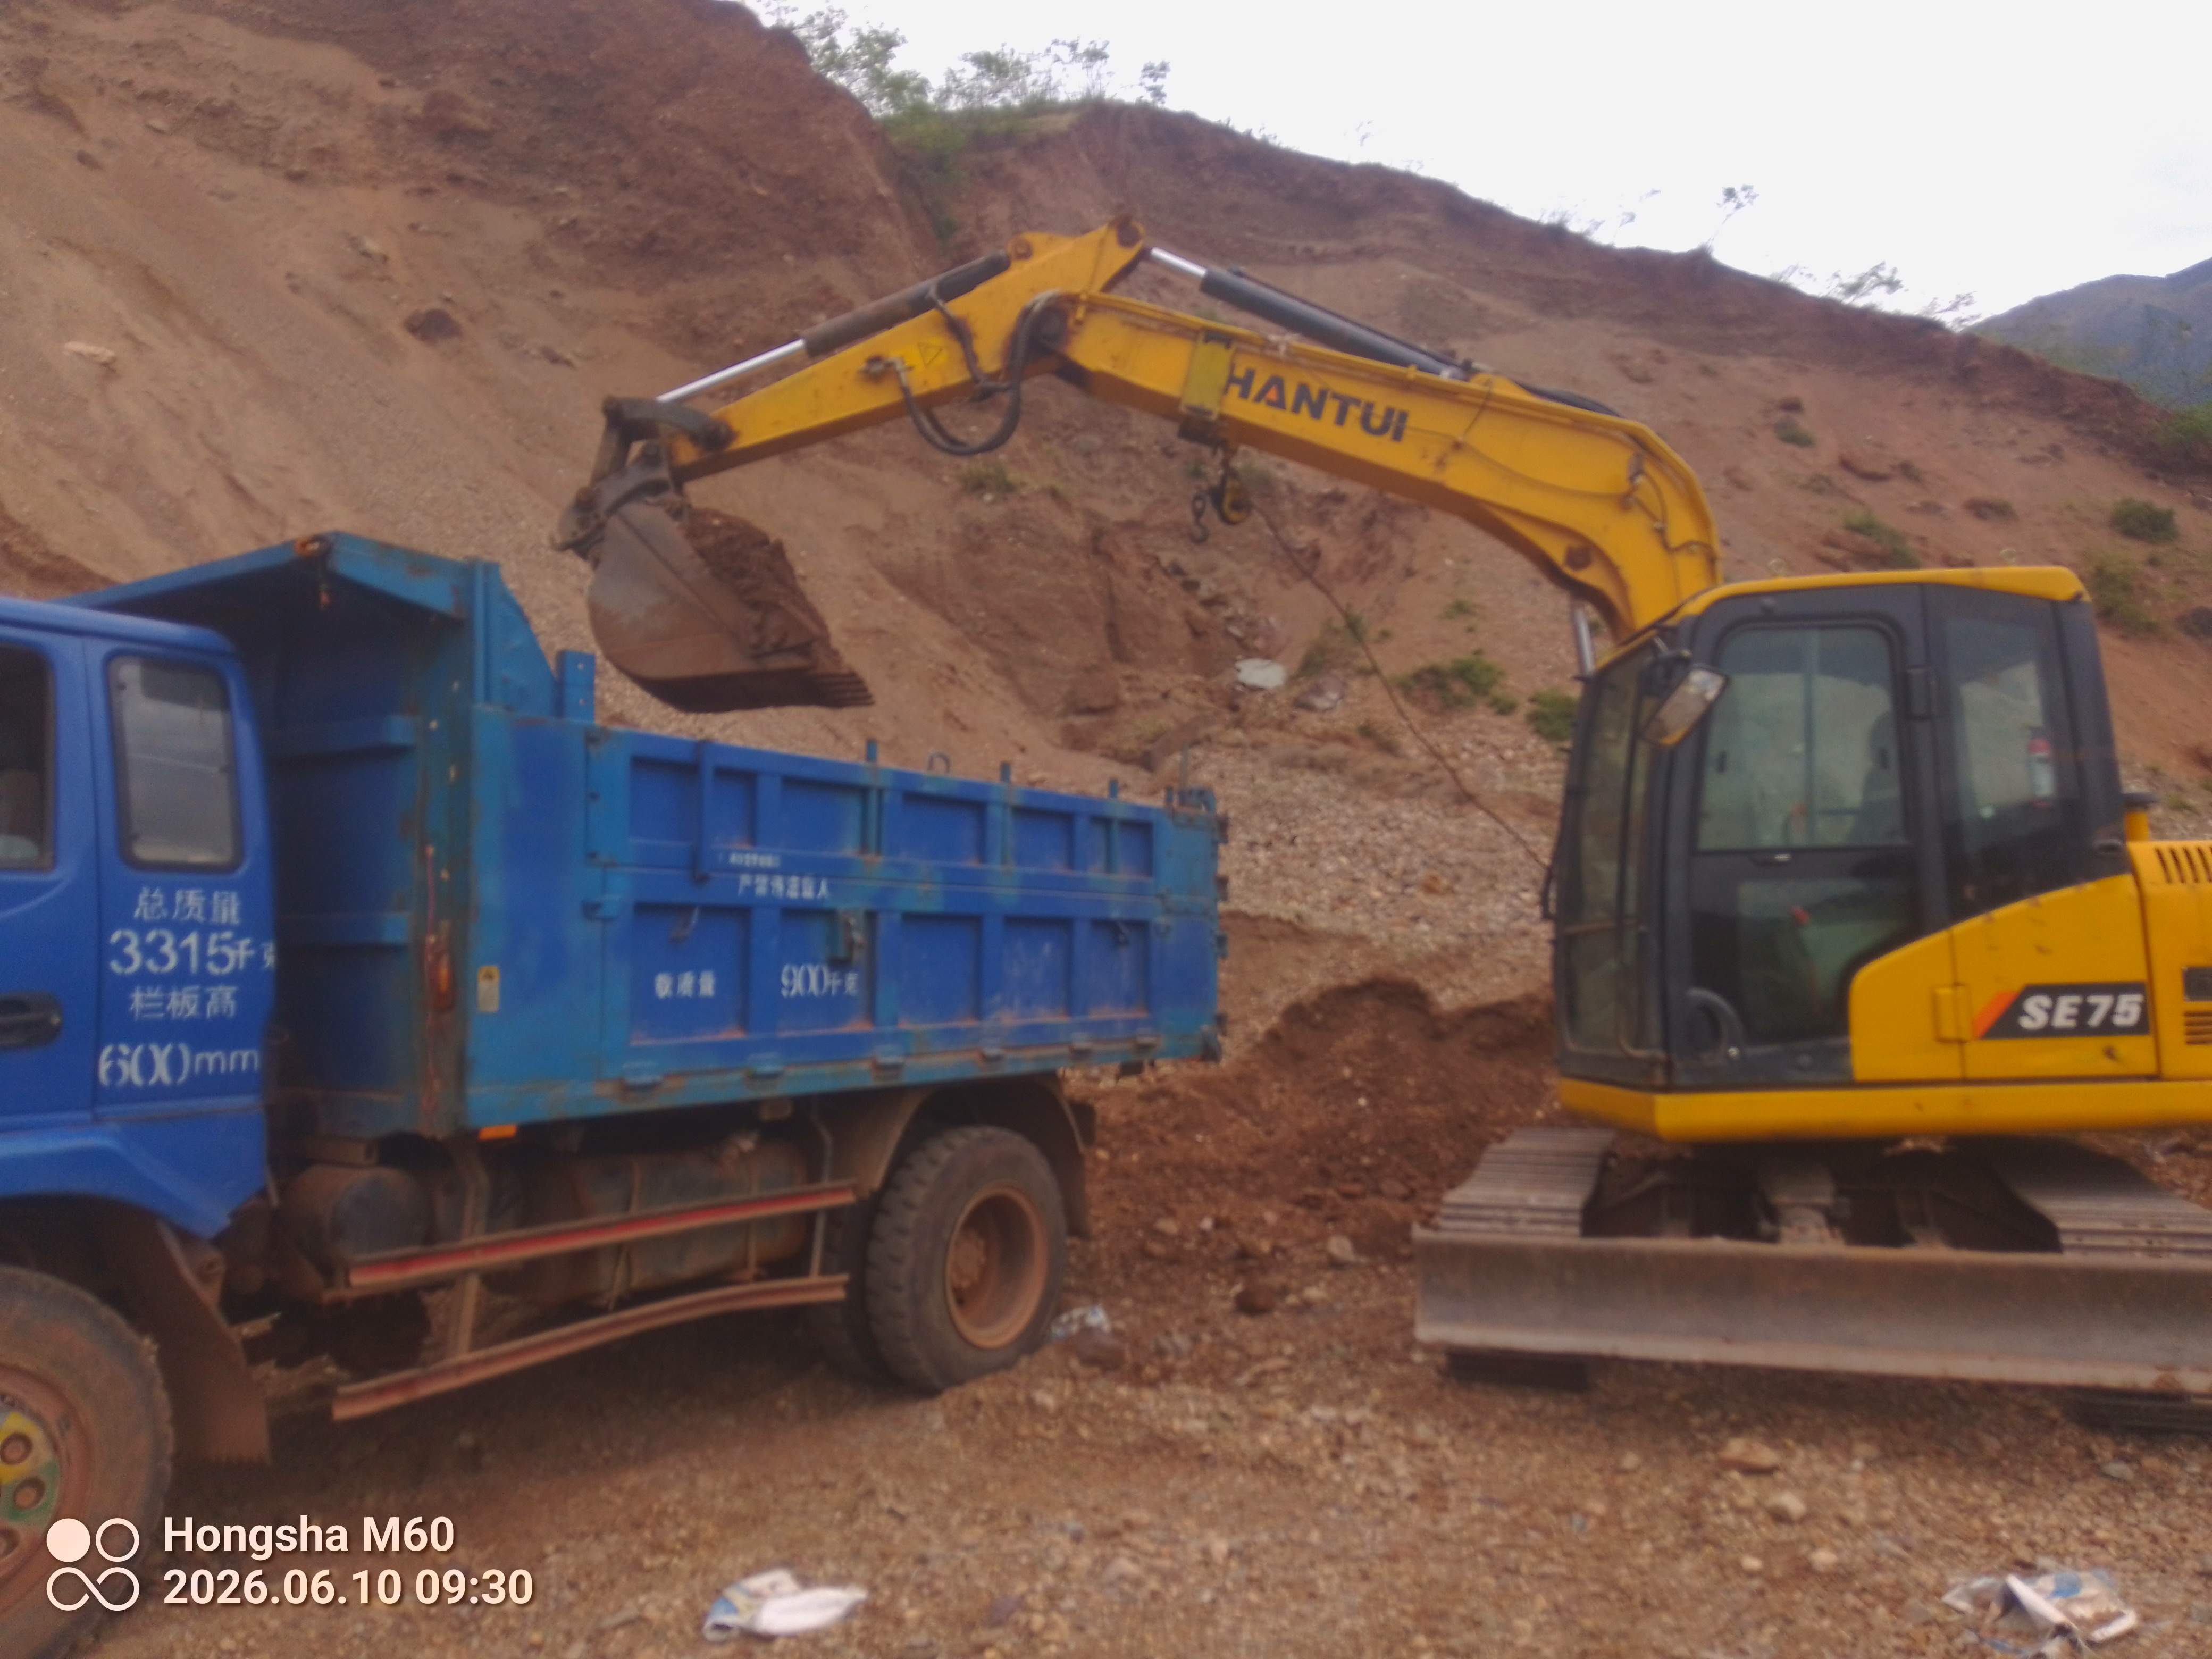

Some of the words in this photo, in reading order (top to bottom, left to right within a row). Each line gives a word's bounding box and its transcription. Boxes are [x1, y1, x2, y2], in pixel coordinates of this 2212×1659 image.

[1225, 365, 1409, 442] HANTUI
[134, 887, 241, 925] 总质量
[130, 985, 237, 1021] 栏板高
[2017, 993, 2144, 1031] SE75
